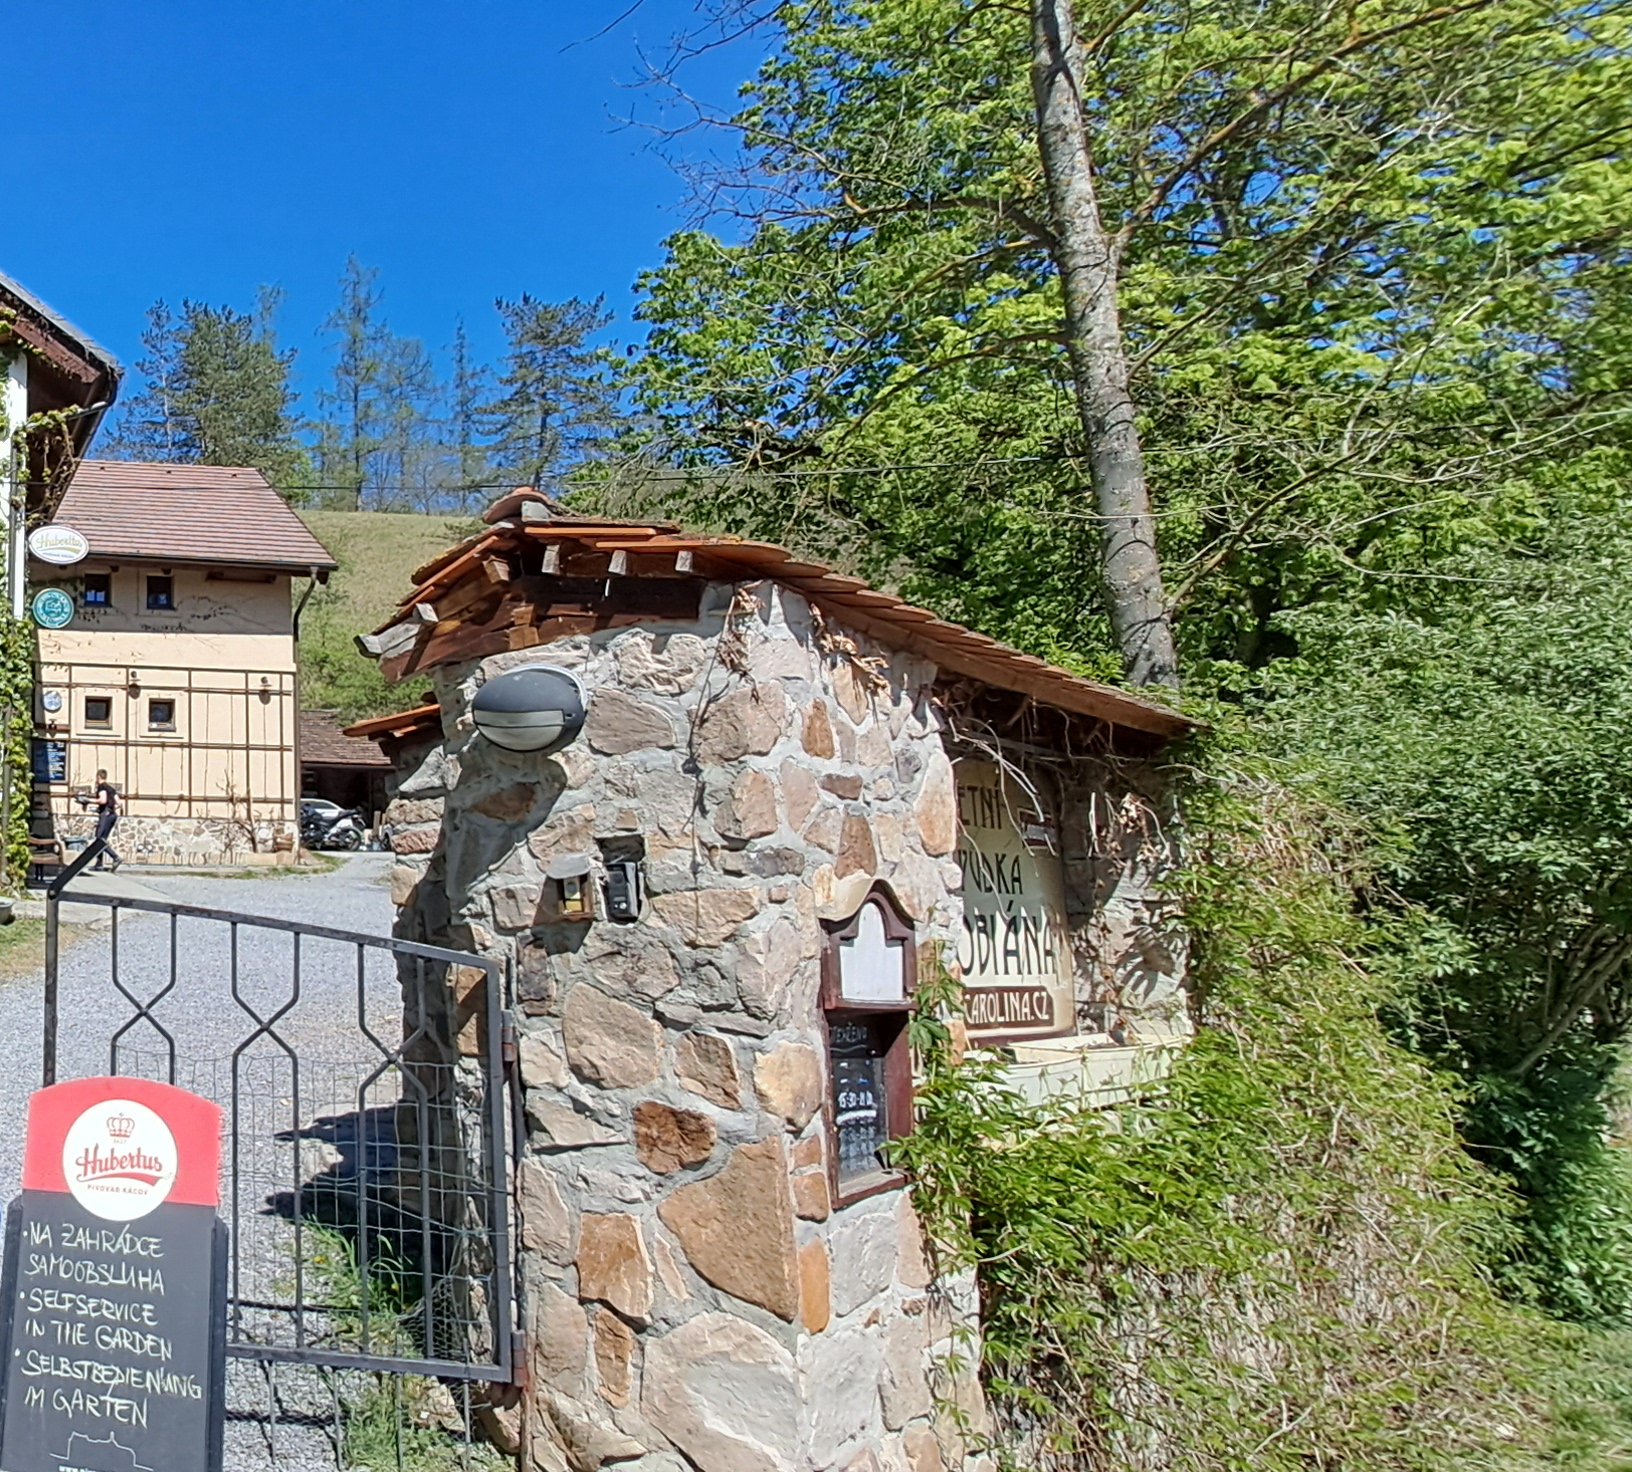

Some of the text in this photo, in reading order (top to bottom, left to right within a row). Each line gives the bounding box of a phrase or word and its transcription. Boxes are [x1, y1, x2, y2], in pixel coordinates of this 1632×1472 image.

[957, 780, 1002, 830] ETNÍ
[958, 900, 1057, 977] OBIÁNA
[75, 1142, 163, 1178] Hubertus
[87, 1184, 121, 1193] PIVOVAR
[30, 1221, 165, 1258] NA ZAHRÁDCE
[24, 1252, 165, 1296] SAMOOBSLUHA
[27, 1287, 159, 1326] SELFSERVICE
[25, 1319, 173, 1362] IN THE GARDEN
[52, 1387, 148, 1429] GARTEN
